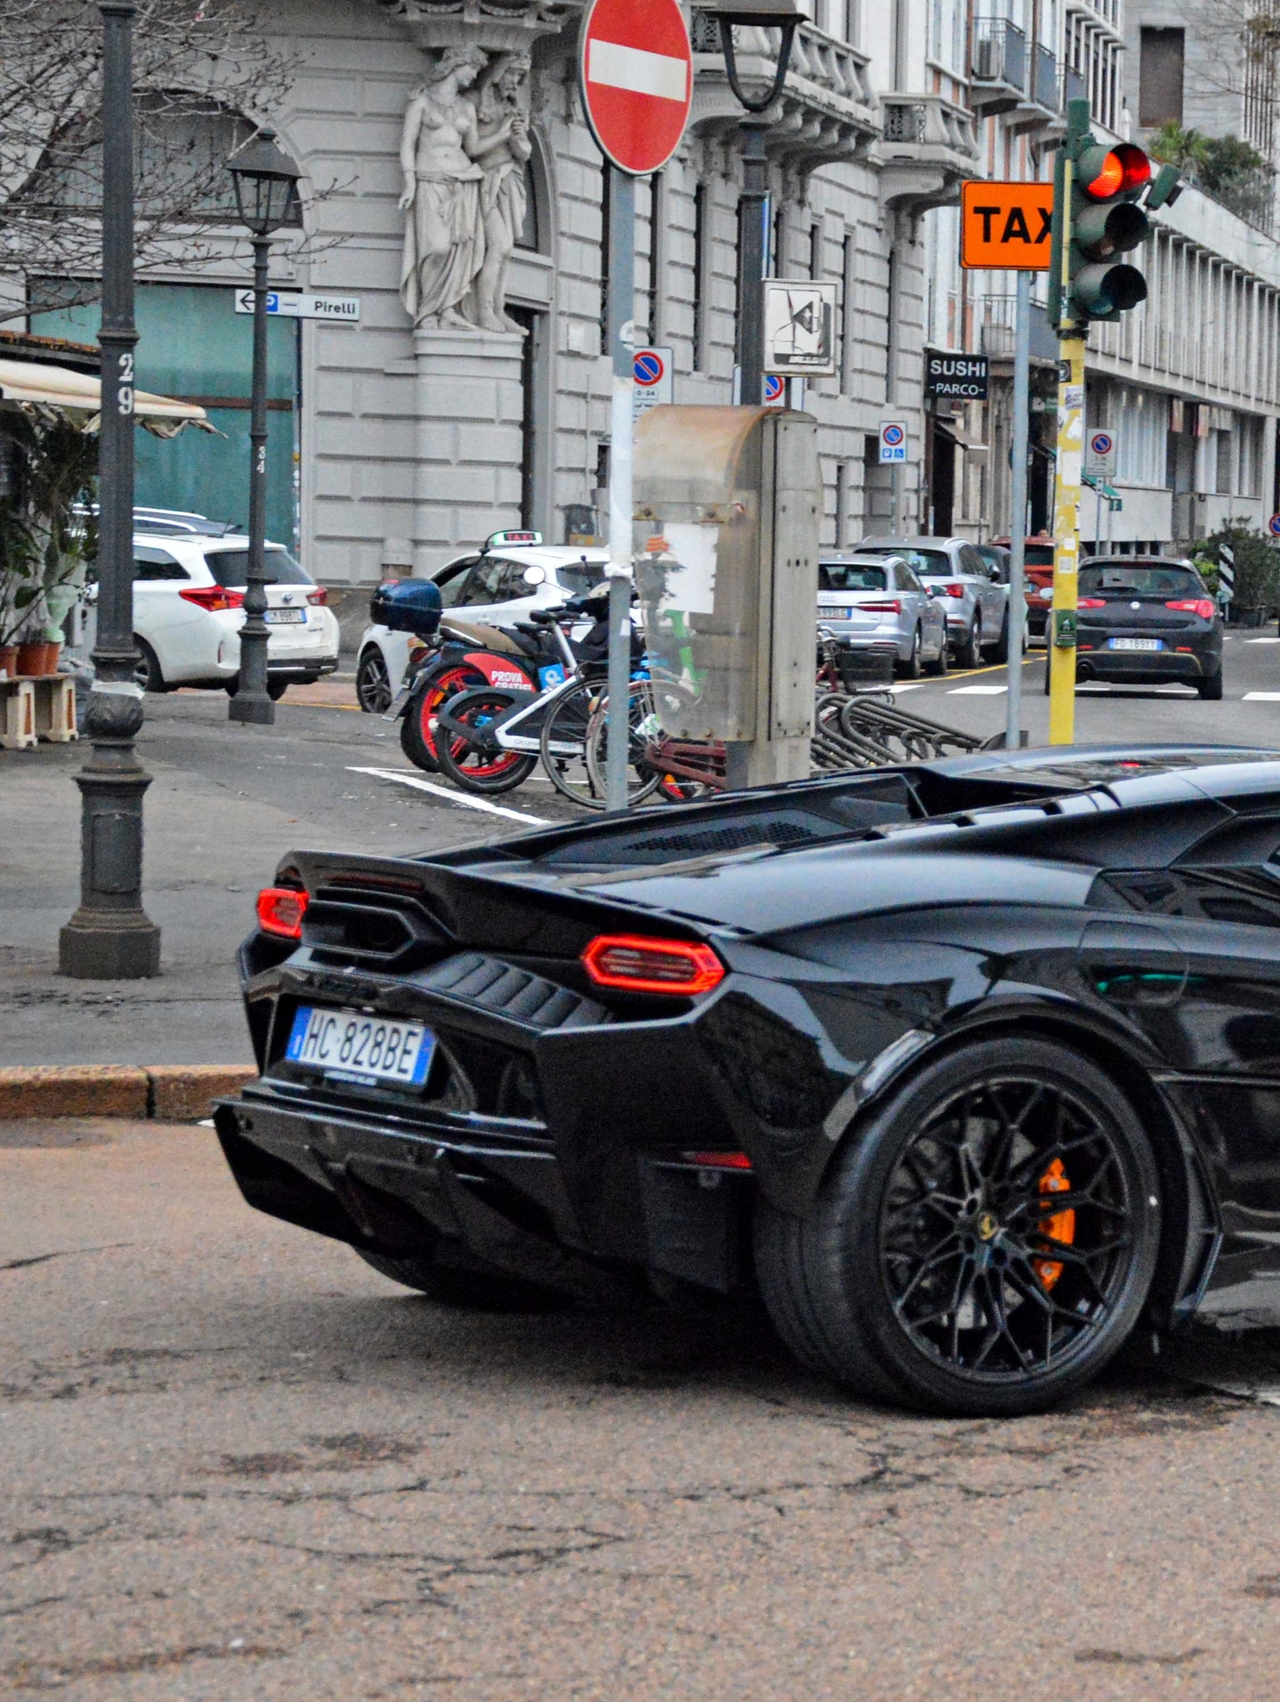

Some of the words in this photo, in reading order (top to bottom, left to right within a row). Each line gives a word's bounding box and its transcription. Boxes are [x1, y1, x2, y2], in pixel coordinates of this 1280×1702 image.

[314, 301, 356, 314] Pirelli
[930, 359, 986, 378] SUSHI
[118, 353, 134, 415] 29
[257, 446, 266, 473] 34
[507, 533, 534, 541] TAXI
[491, 670, 522, 683] PROVA
[304, 1013, 336, 1060] HC
[340, 1020, 420, 1074] 828BE
